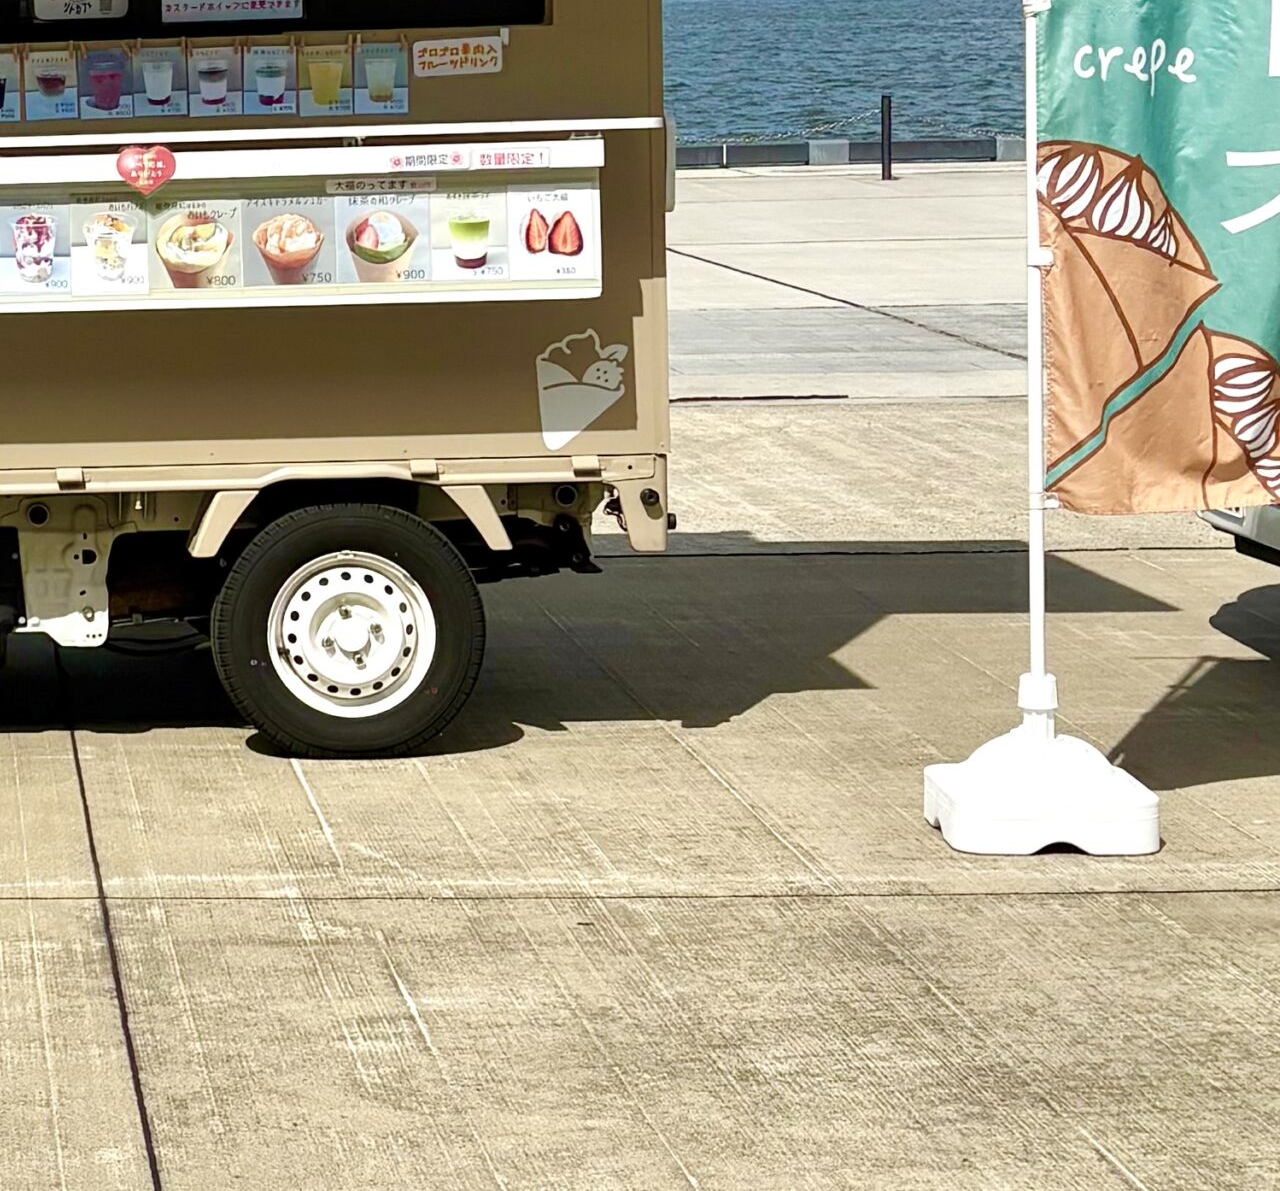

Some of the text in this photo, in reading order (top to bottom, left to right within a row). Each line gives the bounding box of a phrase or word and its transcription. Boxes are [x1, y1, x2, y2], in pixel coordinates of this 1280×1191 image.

[1073, 37, 1198, 98] crepe
[405, 154, 449, 168] 期間限定
[334, 179, 407, 192] 大福のってます
[206, 275, 237, 287] ¥800
[302, 272, 333, 284] ¥750
[396, 269, 426, 281] ¥900
